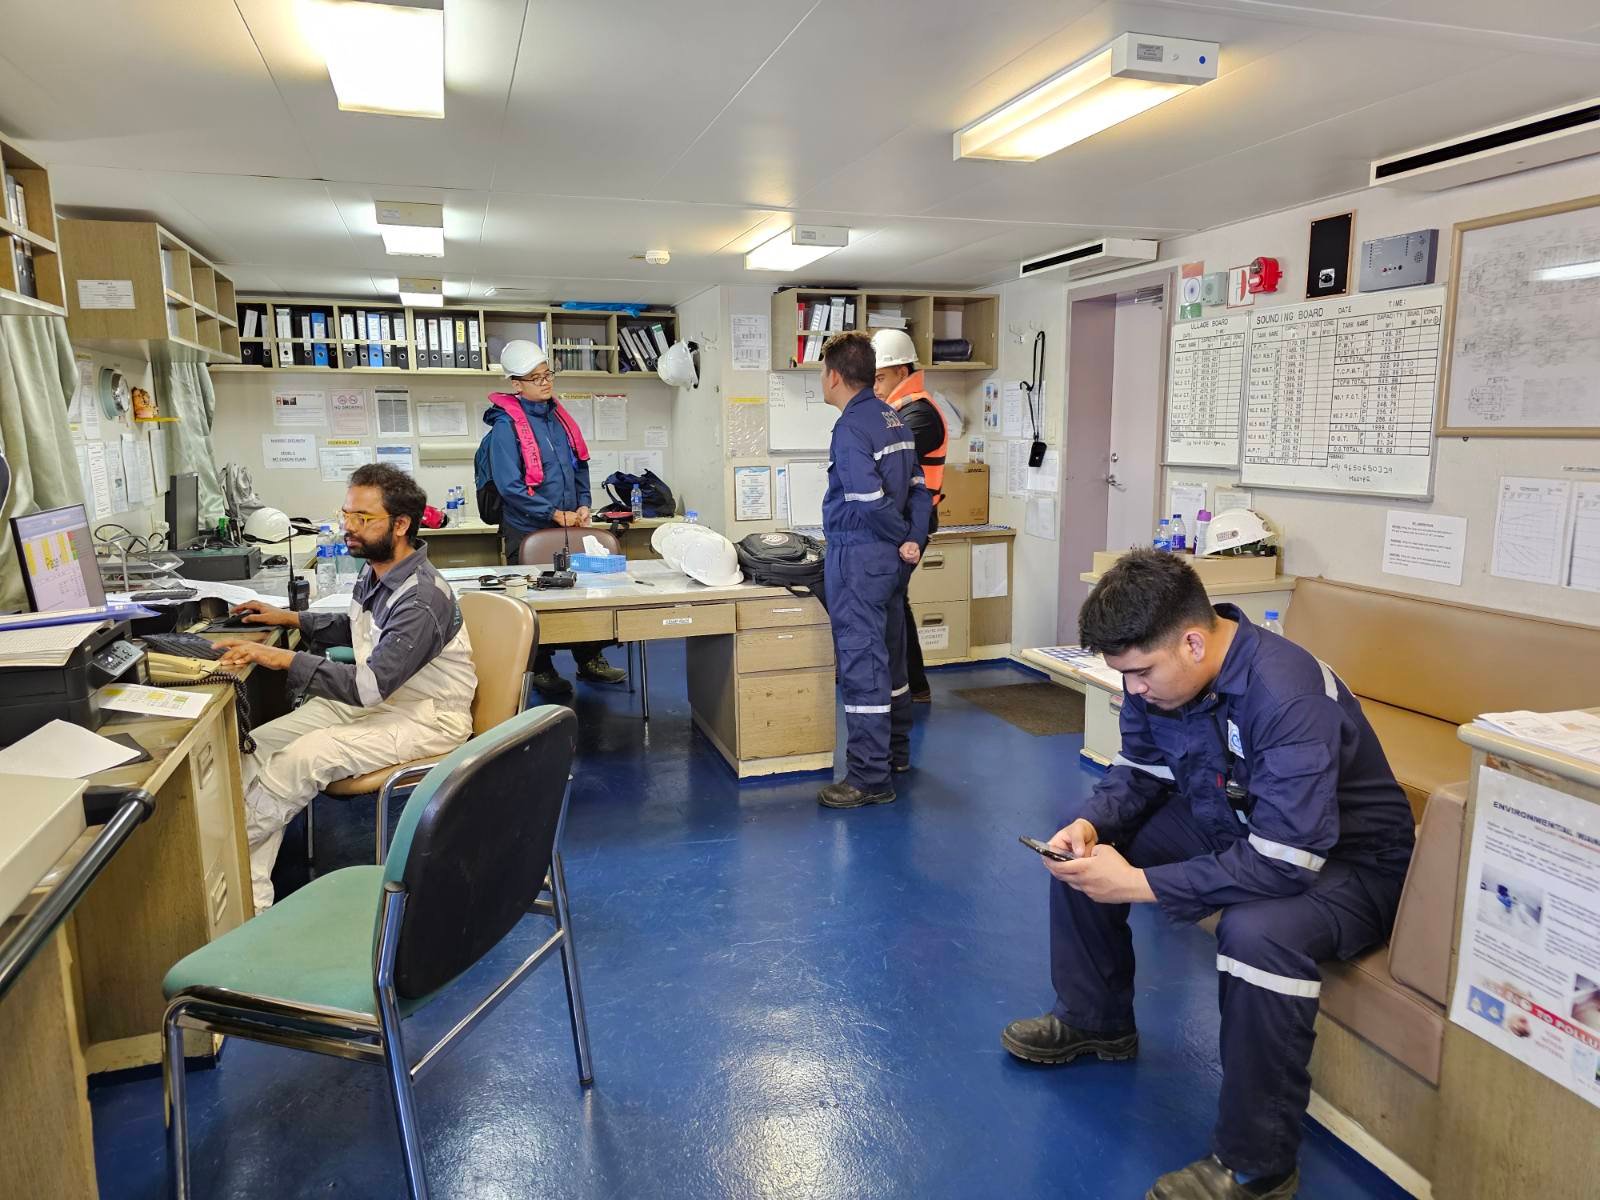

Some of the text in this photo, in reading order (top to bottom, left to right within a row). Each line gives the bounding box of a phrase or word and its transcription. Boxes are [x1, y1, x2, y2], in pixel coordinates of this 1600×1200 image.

[1256, 306, 1352, 325] SOUNDING BOARD DATE
[1356, 319, 1369, 327] NAME
[1190, 318, 1229, 330] ULLAGE BOARD
[1492, 801, 1574, 836] ENVIRONMENTAL
